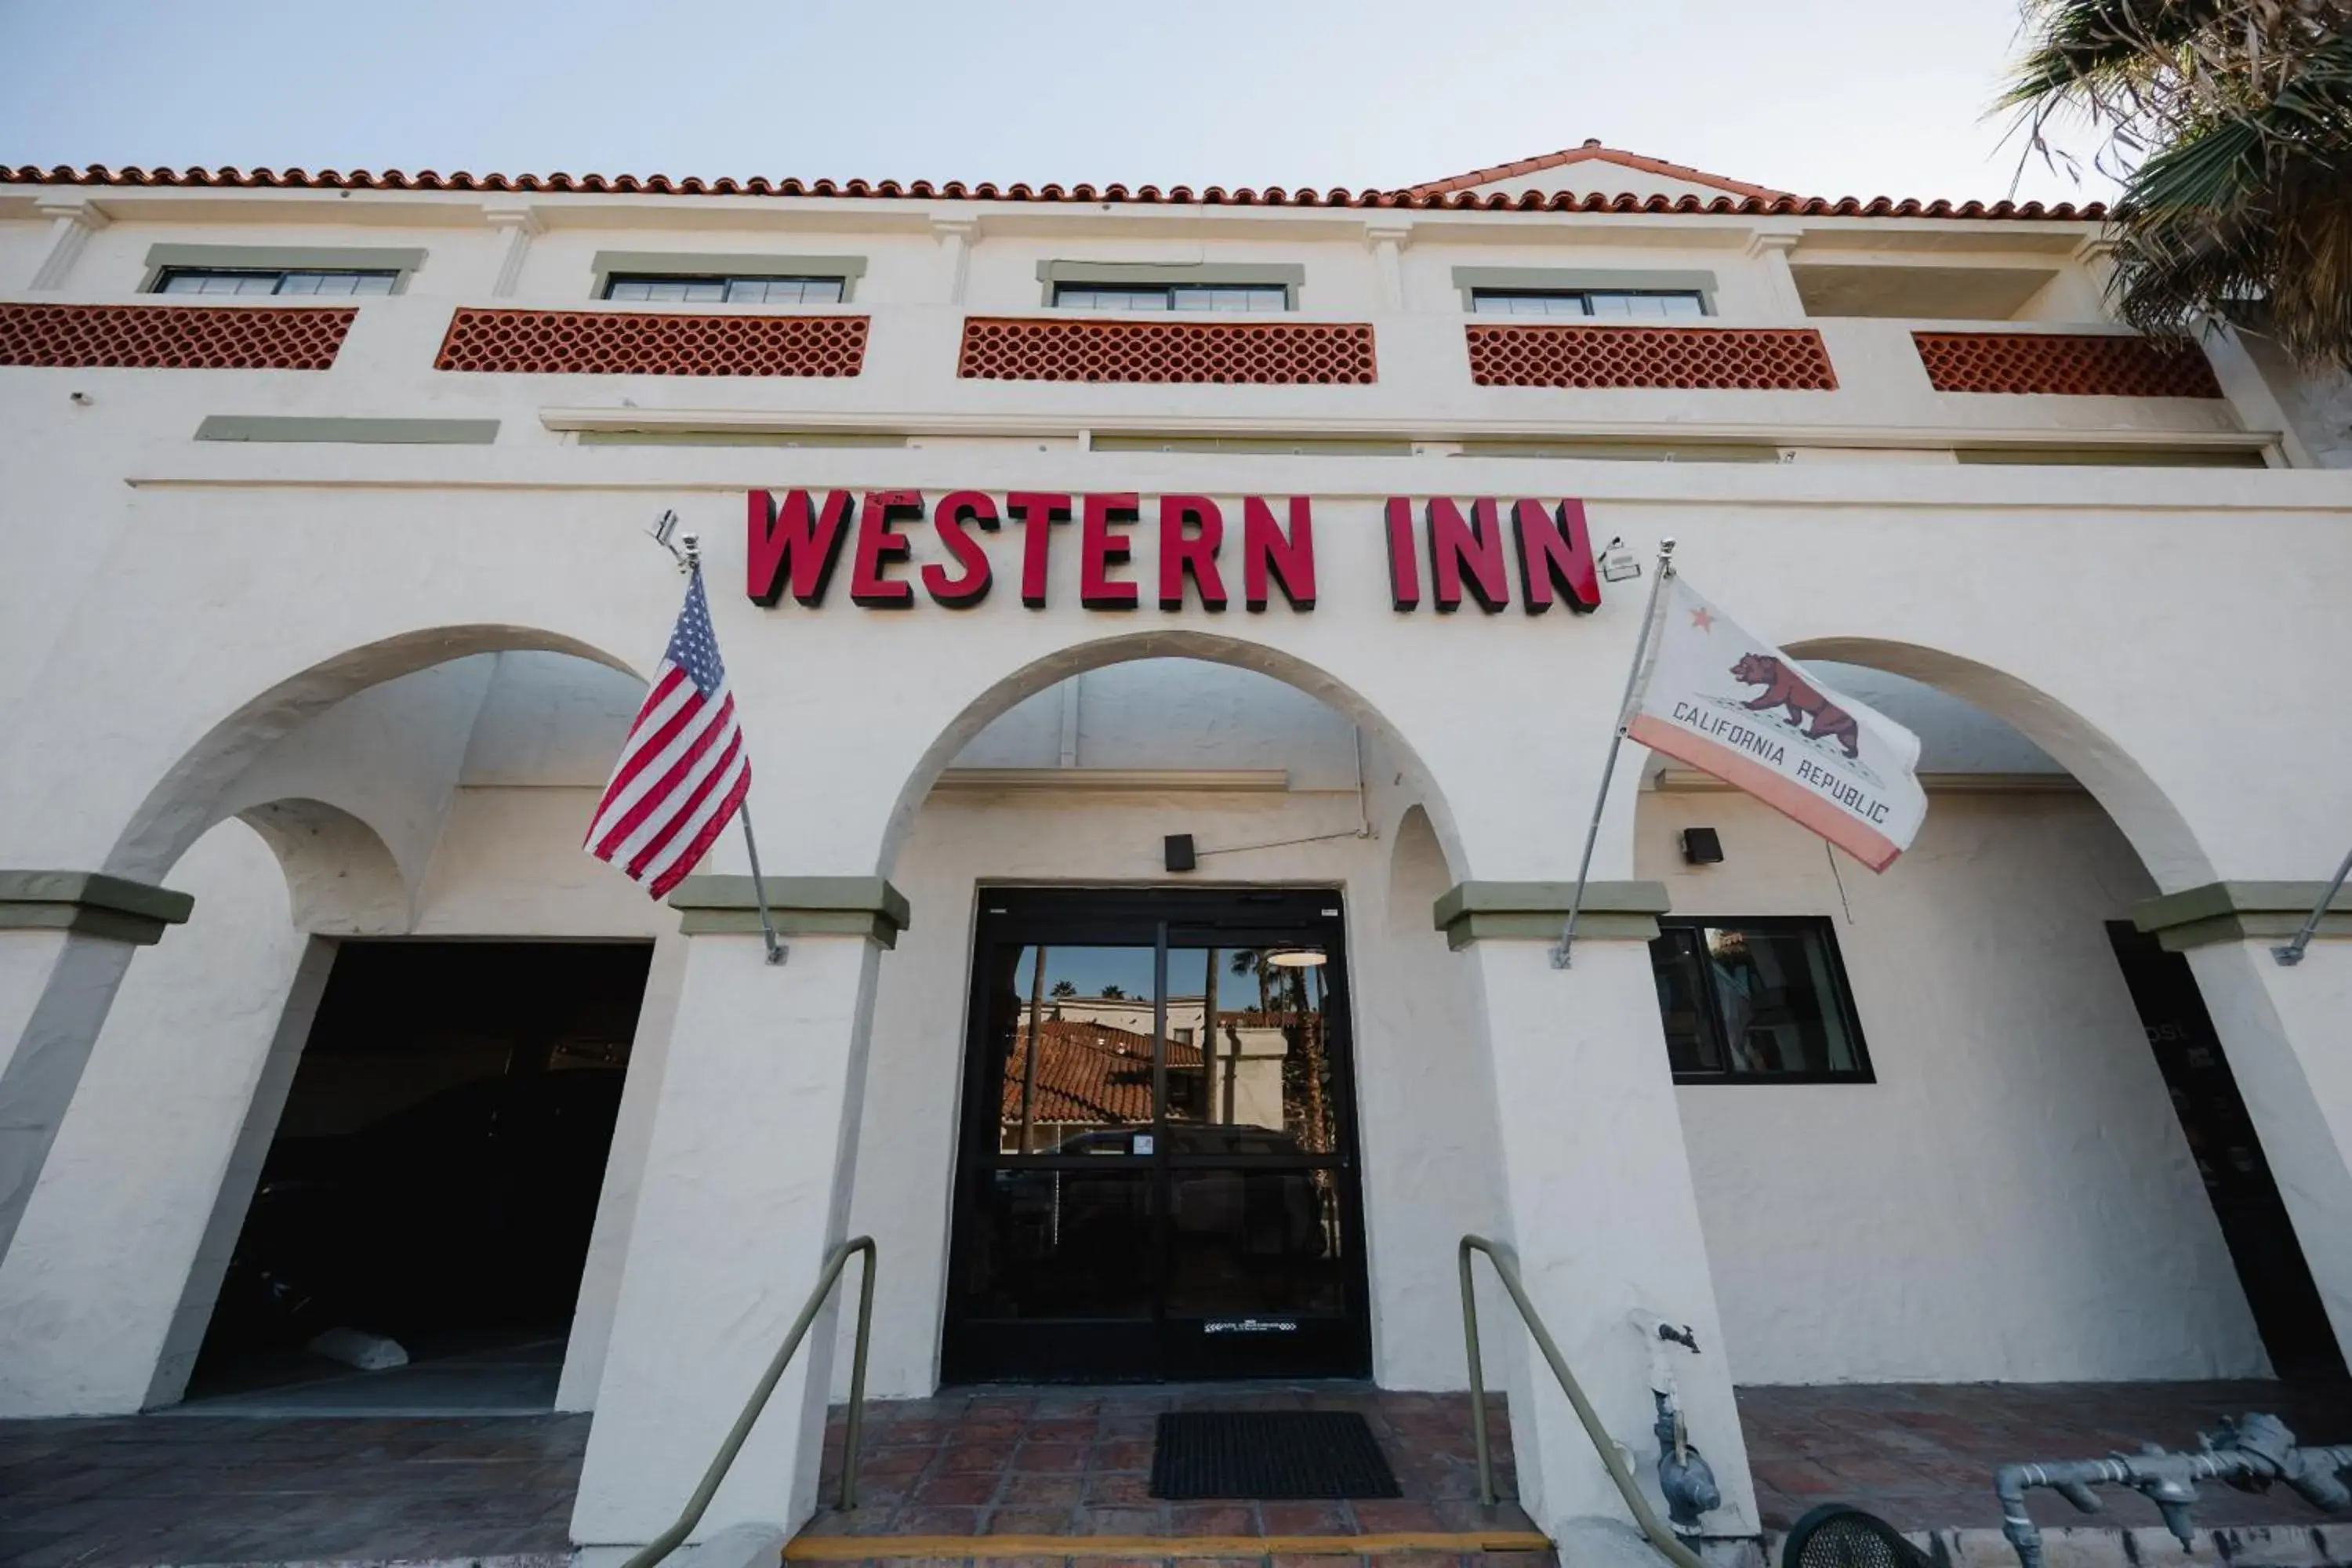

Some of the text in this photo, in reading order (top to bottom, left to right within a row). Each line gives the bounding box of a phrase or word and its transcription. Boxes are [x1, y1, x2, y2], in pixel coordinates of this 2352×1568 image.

[747, 489, 1602, 614] WESTERN INN
[1672, 702, 1889, 825] CALIFORNIA REPUBLIC
